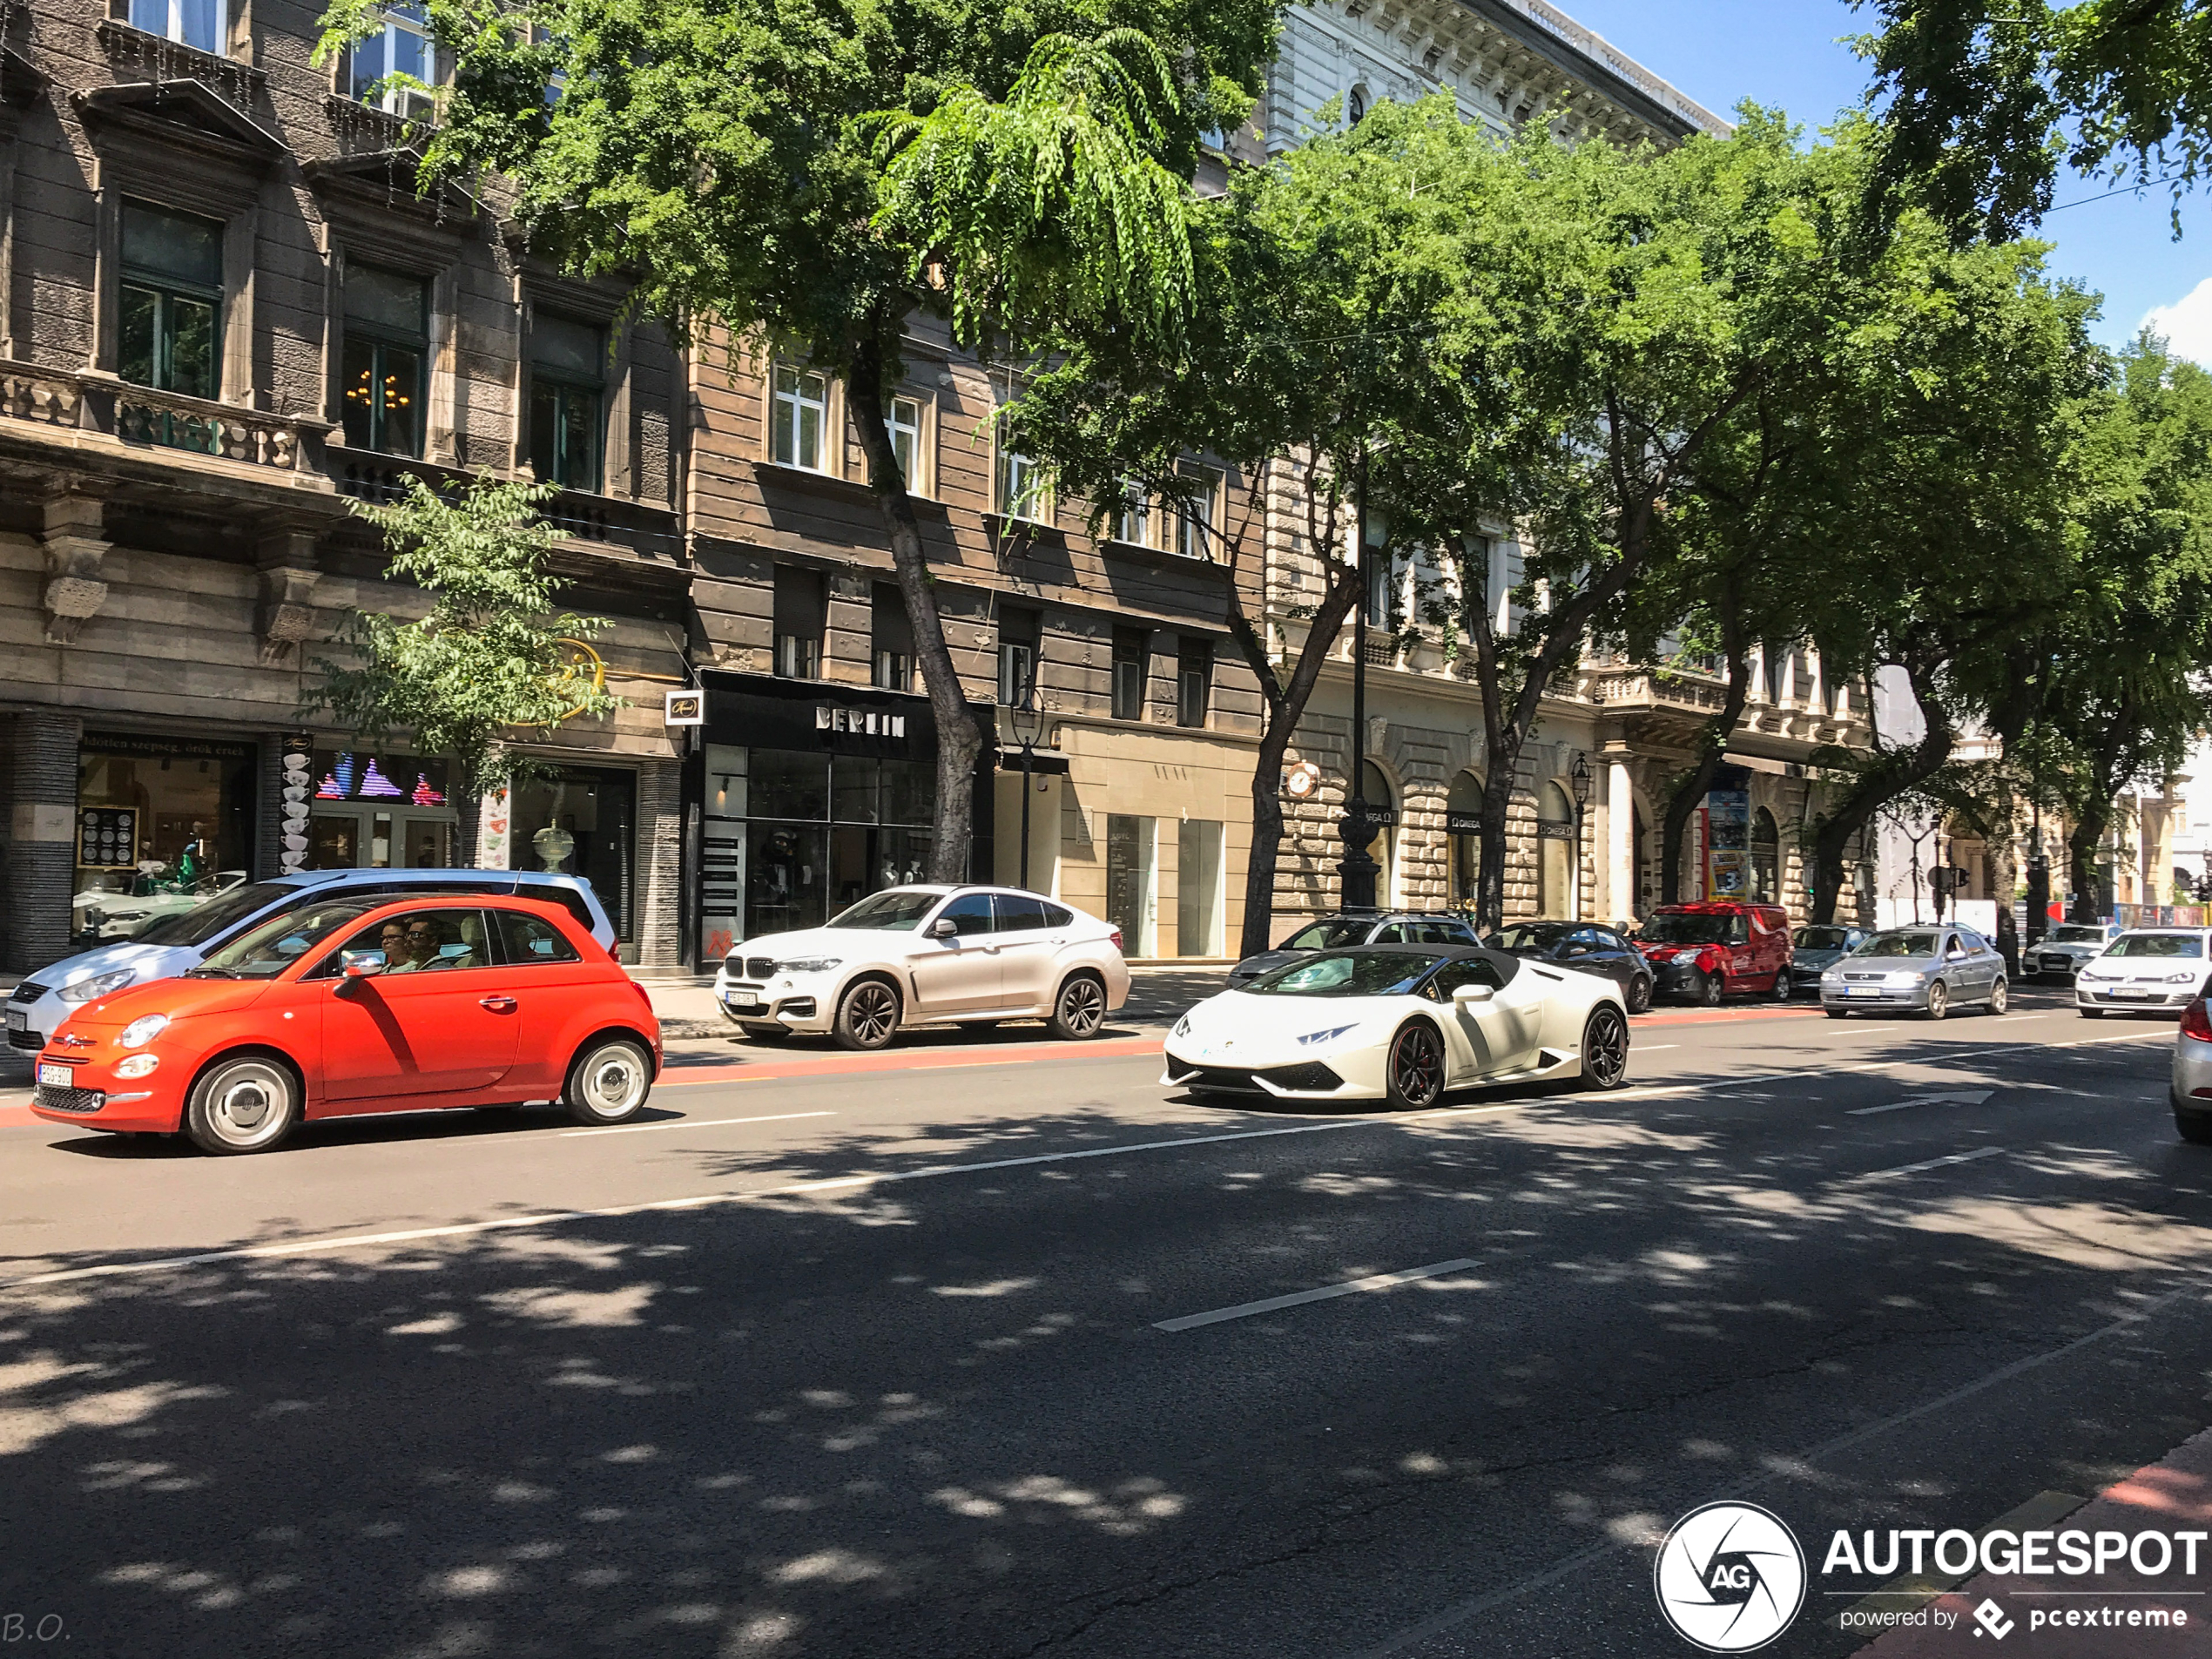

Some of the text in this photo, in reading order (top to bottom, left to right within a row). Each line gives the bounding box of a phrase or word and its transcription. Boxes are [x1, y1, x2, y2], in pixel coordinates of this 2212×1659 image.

[816, 706, 905, 738] BERLIN
[1460, 819, 1481, 829] OMEGA
[42, 1065, 71, 1084] PSG-900
